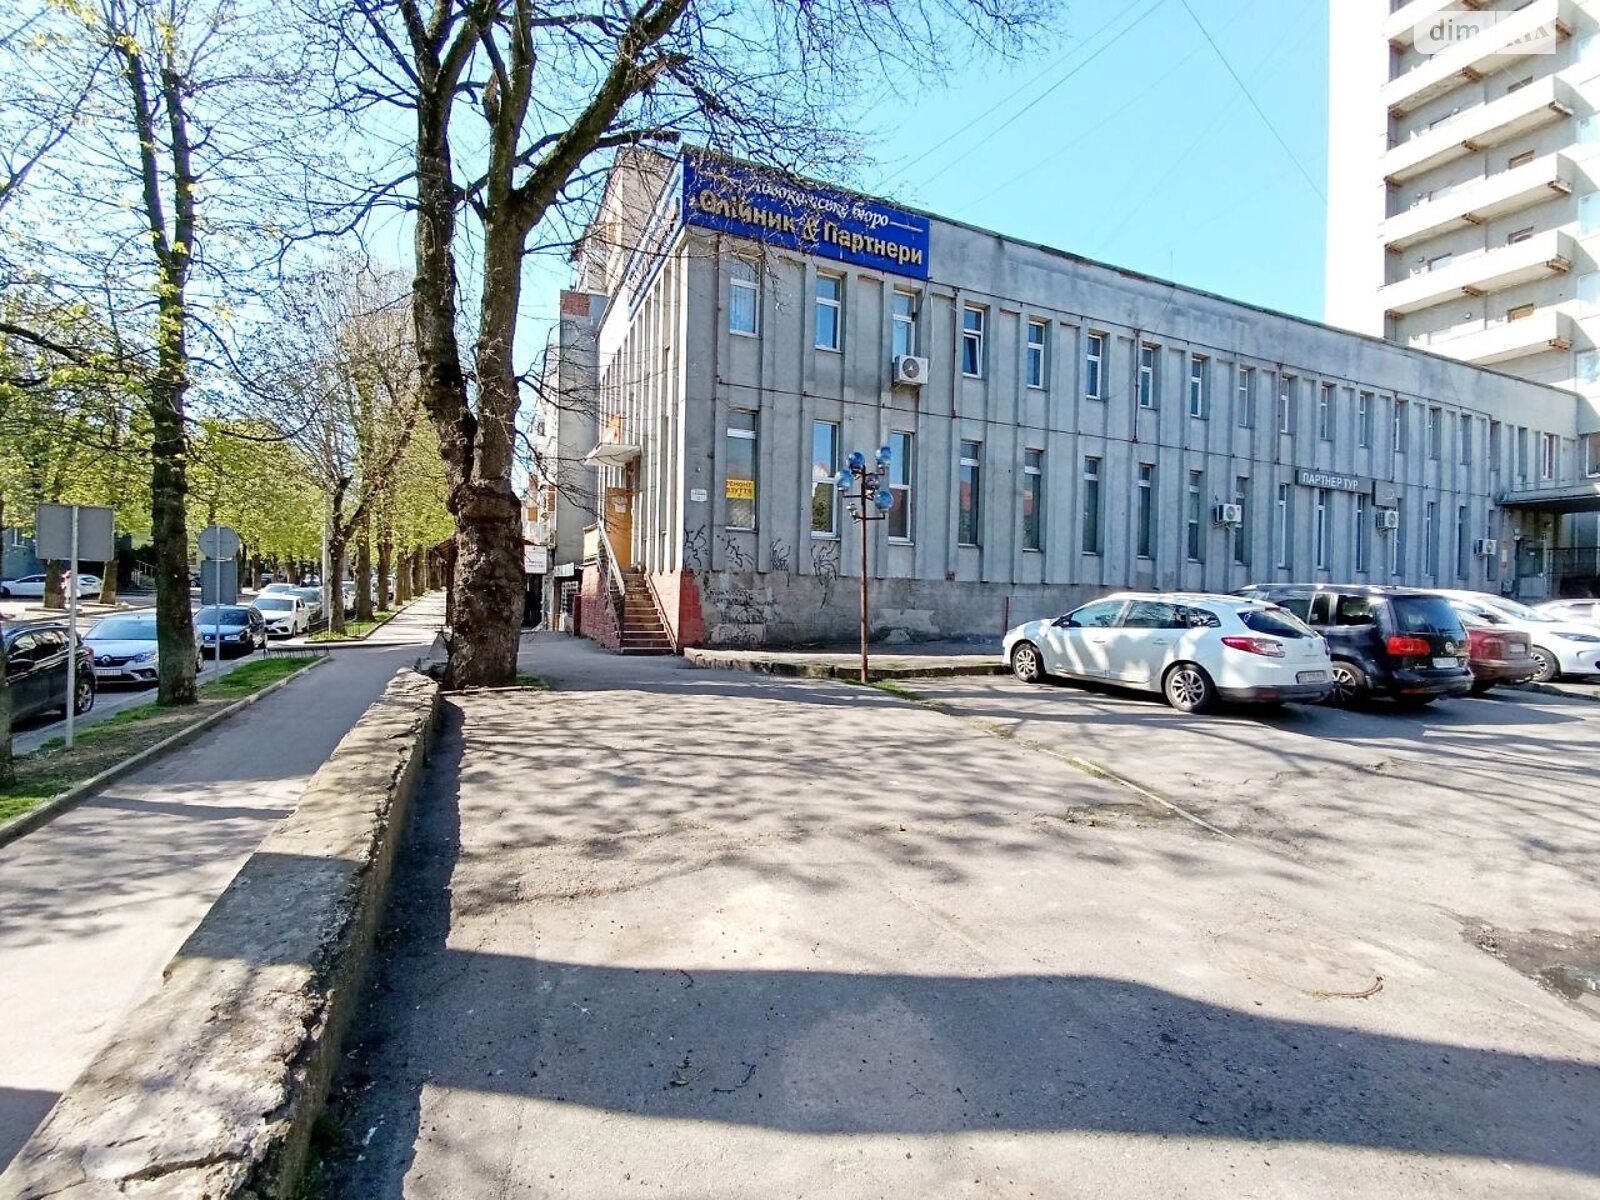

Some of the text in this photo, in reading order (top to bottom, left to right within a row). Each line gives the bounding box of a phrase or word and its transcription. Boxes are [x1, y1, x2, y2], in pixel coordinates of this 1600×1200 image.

[699, 189, 922, 265] Олійник & Партнери
[851, 201, 889, 228] бюро
[1303, 472, 1358, 489] ПАРТНЕР ТУР
